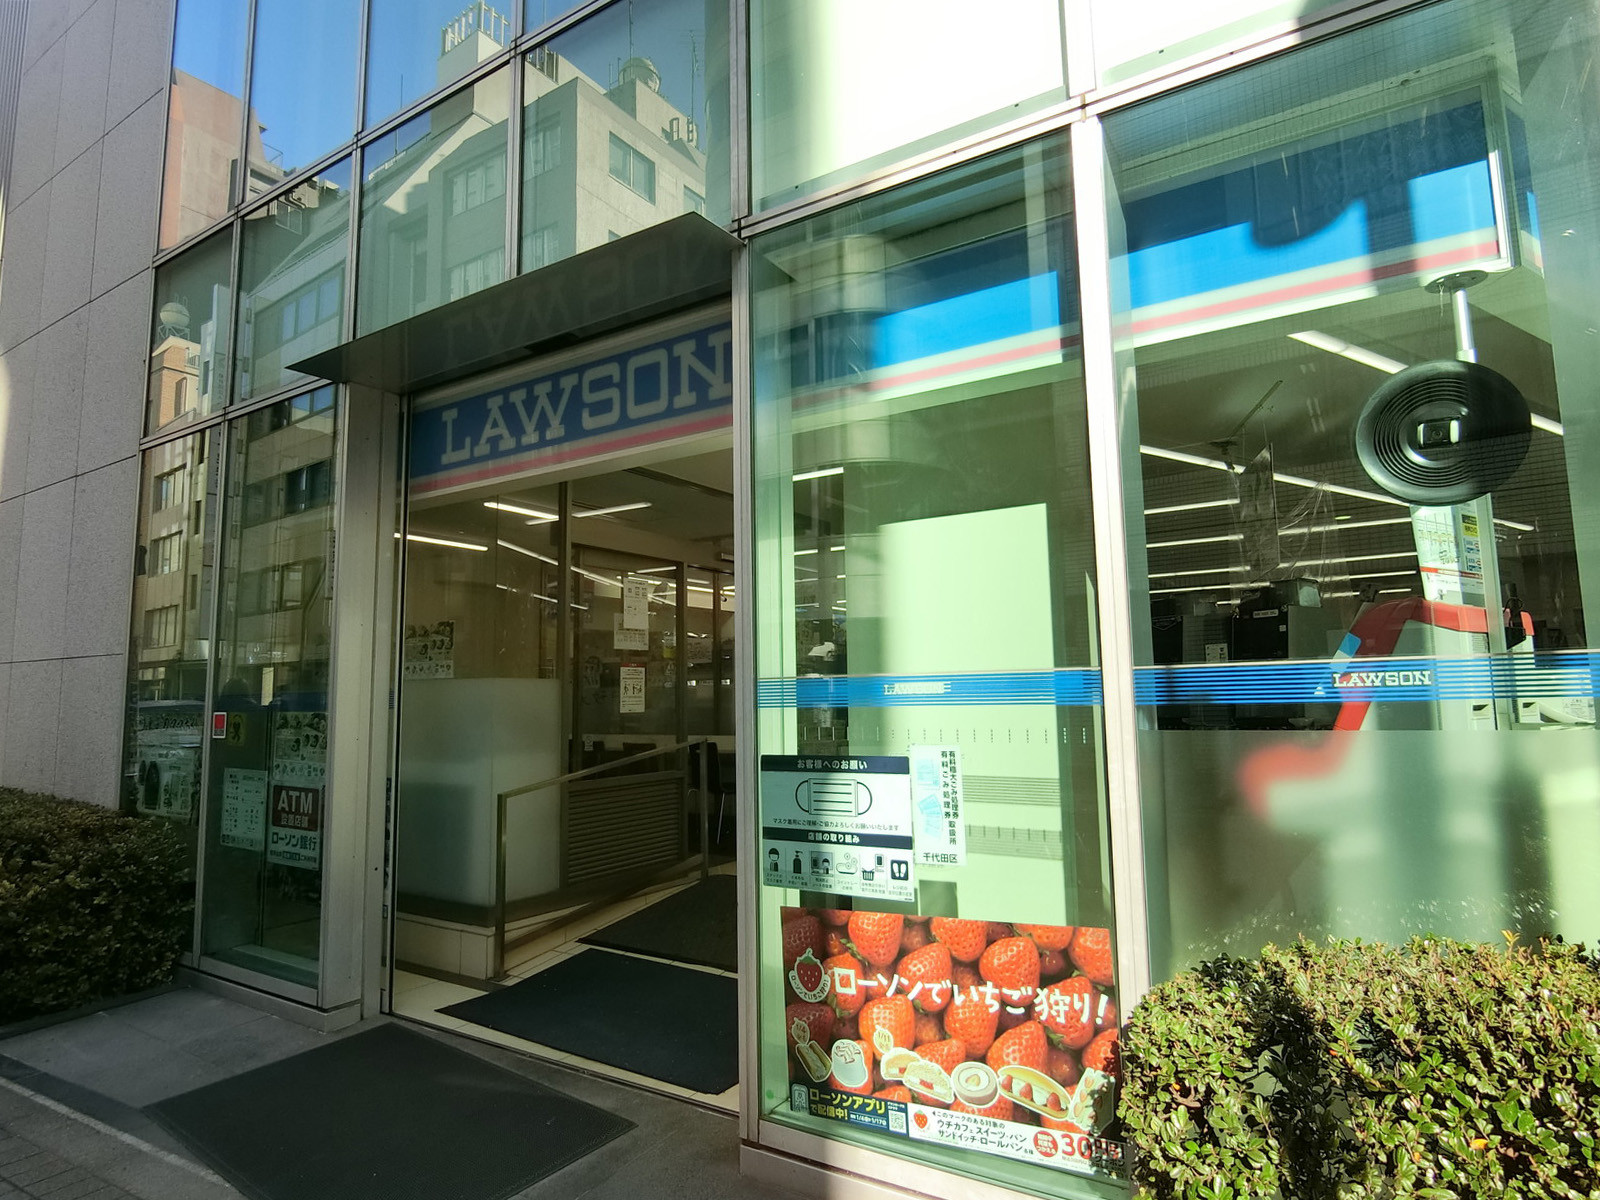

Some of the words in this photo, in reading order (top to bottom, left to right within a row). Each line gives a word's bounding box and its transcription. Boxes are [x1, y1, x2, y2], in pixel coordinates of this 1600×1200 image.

[440, 328, 733, 465] LAWSON
[1332, 670, 1432, 688] LAWSON
[797, 759, 868, 770] お客様へのお願い
[277, 789, 313, 814] ATM
[271, 831, 318, 851] ローソン銀行
[807, 831, 860, 844] 店舗の取り組み
[923, 852, 959, 864] 千代田区
[834, 966, 1108, 1024] ローソンでいちご狩り!
[809, 1088, 886, 1114] ローソンアプリ
[809, 1103, 848, 1120] で配信中!
